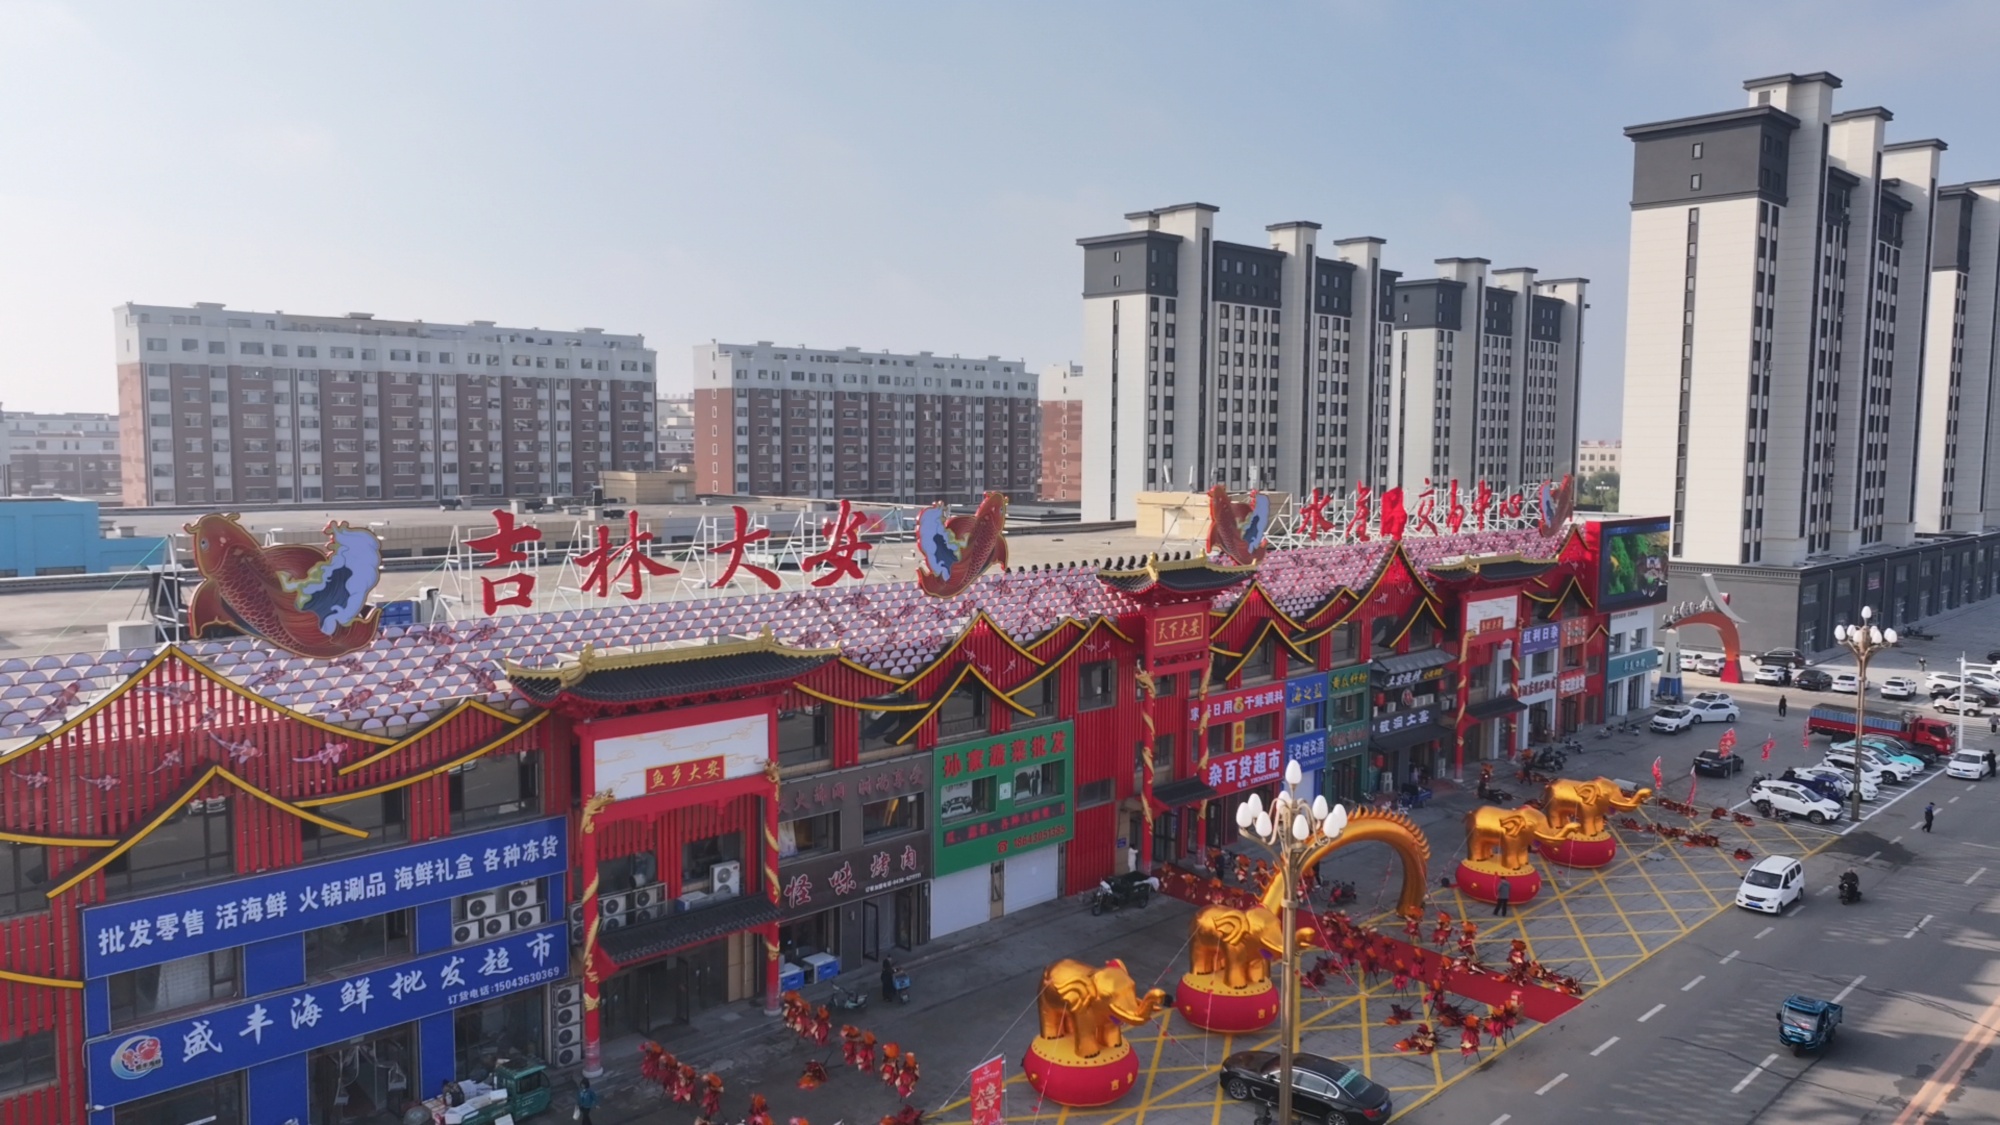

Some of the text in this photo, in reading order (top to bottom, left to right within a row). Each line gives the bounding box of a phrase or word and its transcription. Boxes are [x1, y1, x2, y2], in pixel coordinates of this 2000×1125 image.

[464, 500, 872, 616] 吉林大安
[1158, 617, 1200, 641] 天下大安
[1523, 625, 1559, 644] 红利日杂
[652, 759, 722, 788] 鱼乡大安
[943, 730, 1067, 779] 孙家蔬菜批发
[1209, 748, 1281, 787] 杂百货超市
[98, 834, 558, 956] 批发零售 活海鲜 火锅涮品 海鲜礼盒 各种冻货
[784, 845, 917, 909] 怪味烤肉
[182, 932, 556, 1064] 盛丰海鲜批发超市
